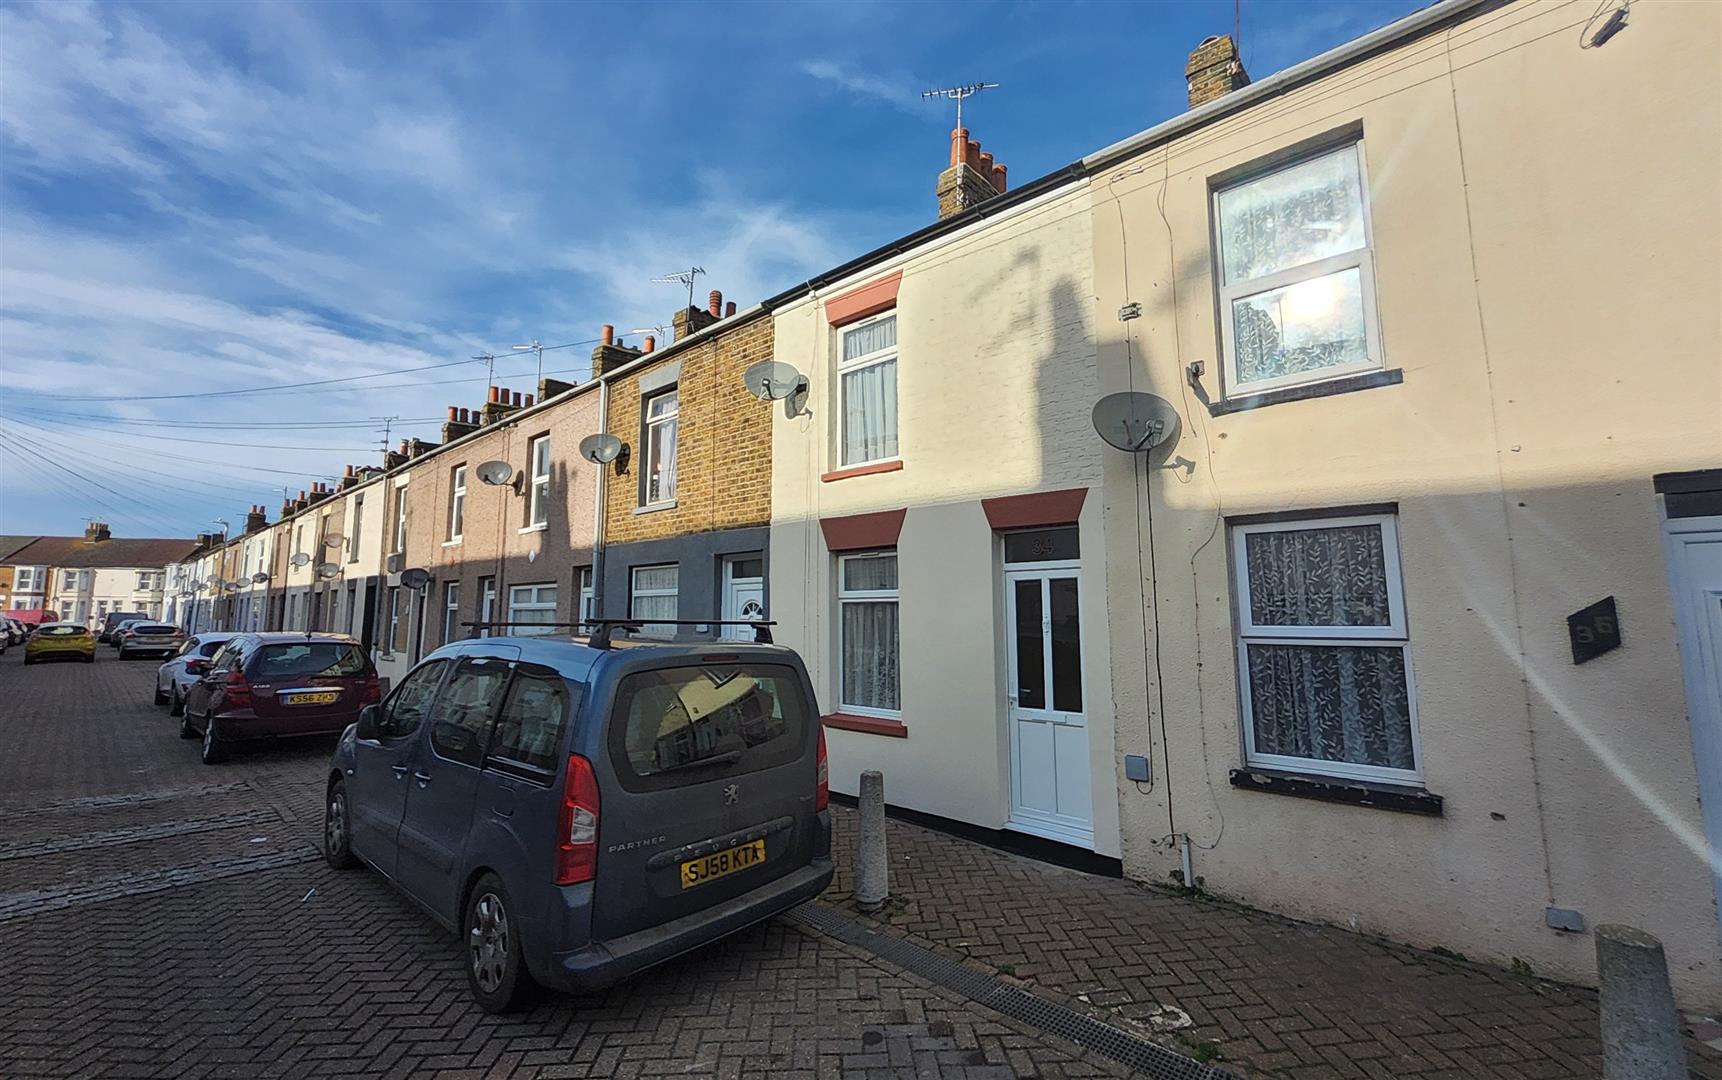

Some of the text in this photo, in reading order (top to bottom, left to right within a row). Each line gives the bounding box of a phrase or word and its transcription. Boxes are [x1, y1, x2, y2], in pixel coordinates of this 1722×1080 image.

[1031, 537, 1055, 555] 34
[608, 835, 666, 853] PARTNER
[688, 844, 760, 882] SJ58 KTA
